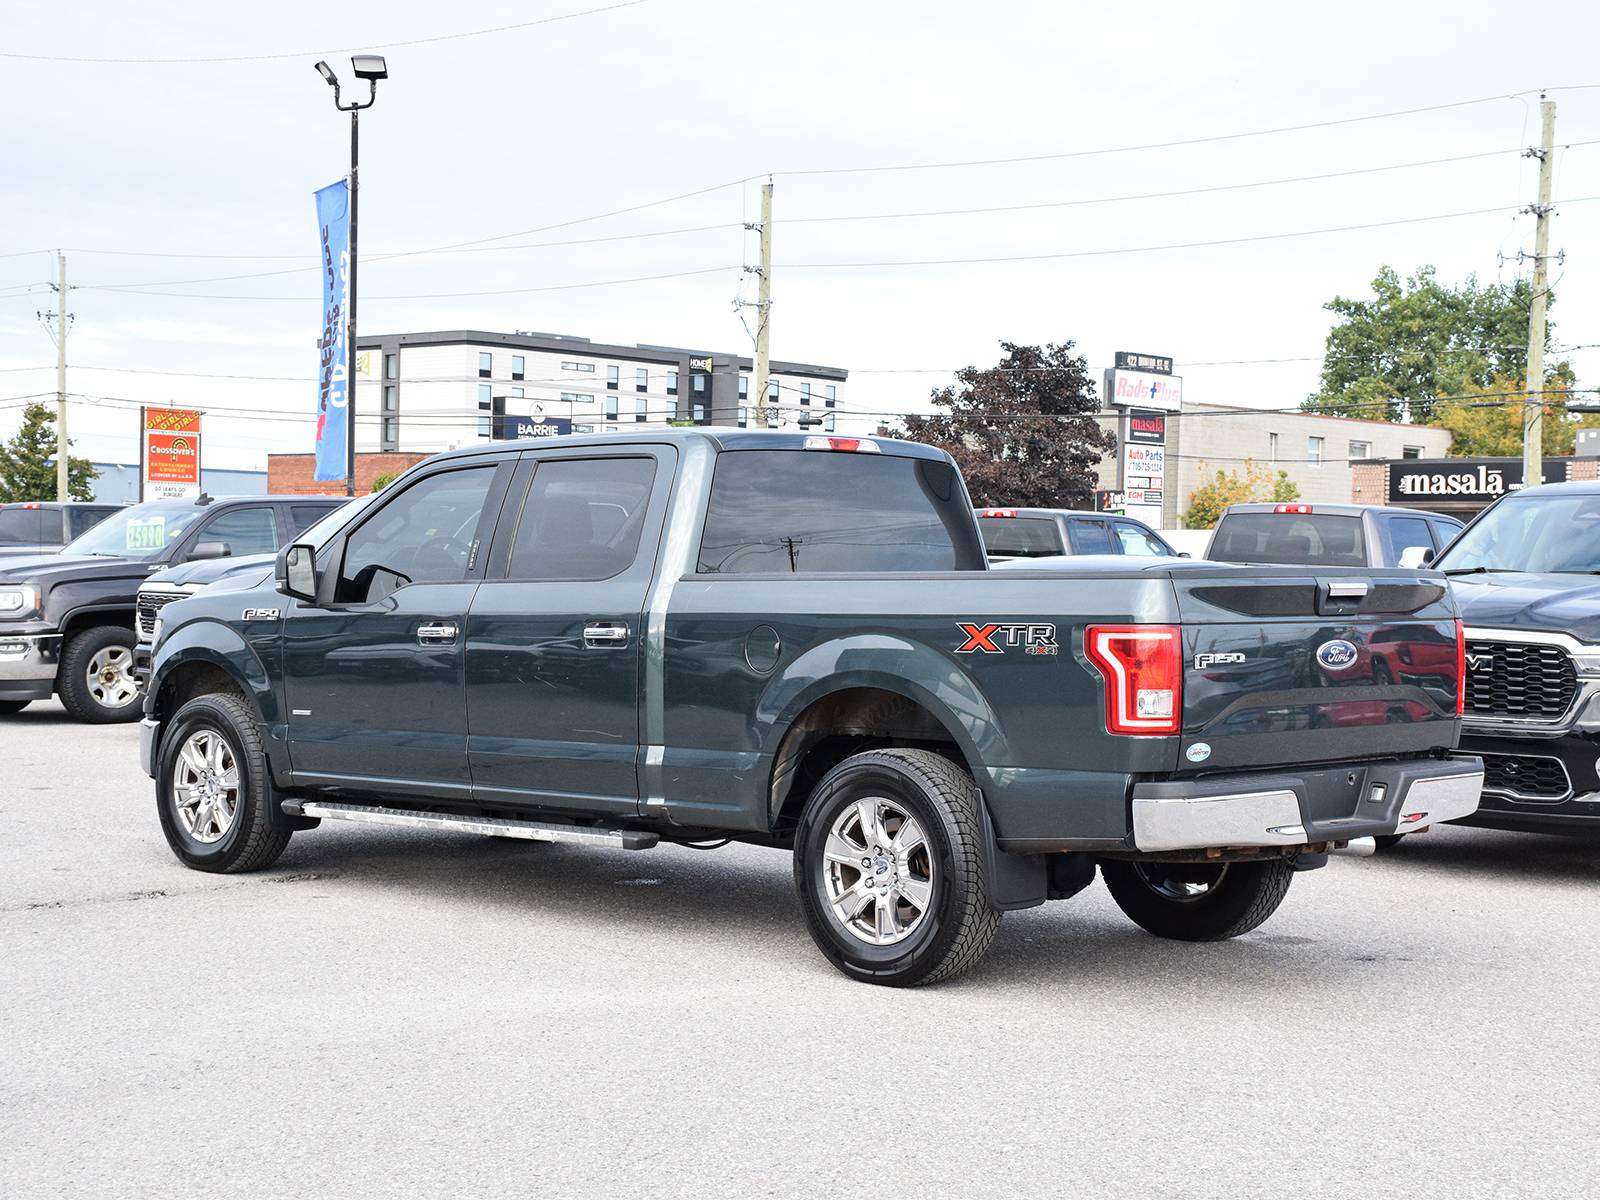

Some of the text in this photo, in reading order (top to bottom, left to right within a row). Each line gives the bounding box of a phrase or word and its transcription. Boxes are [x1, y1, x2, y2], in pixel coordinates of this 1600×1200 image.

[517, 422, 559, 436] BARRIE
[1128, 449, 1163, 461] Auto Parts
[1128, 491, 1143, 500] EGM
[954, 622, 1059, 654] XTR
[1328, 645, 1351, 662] Ford
